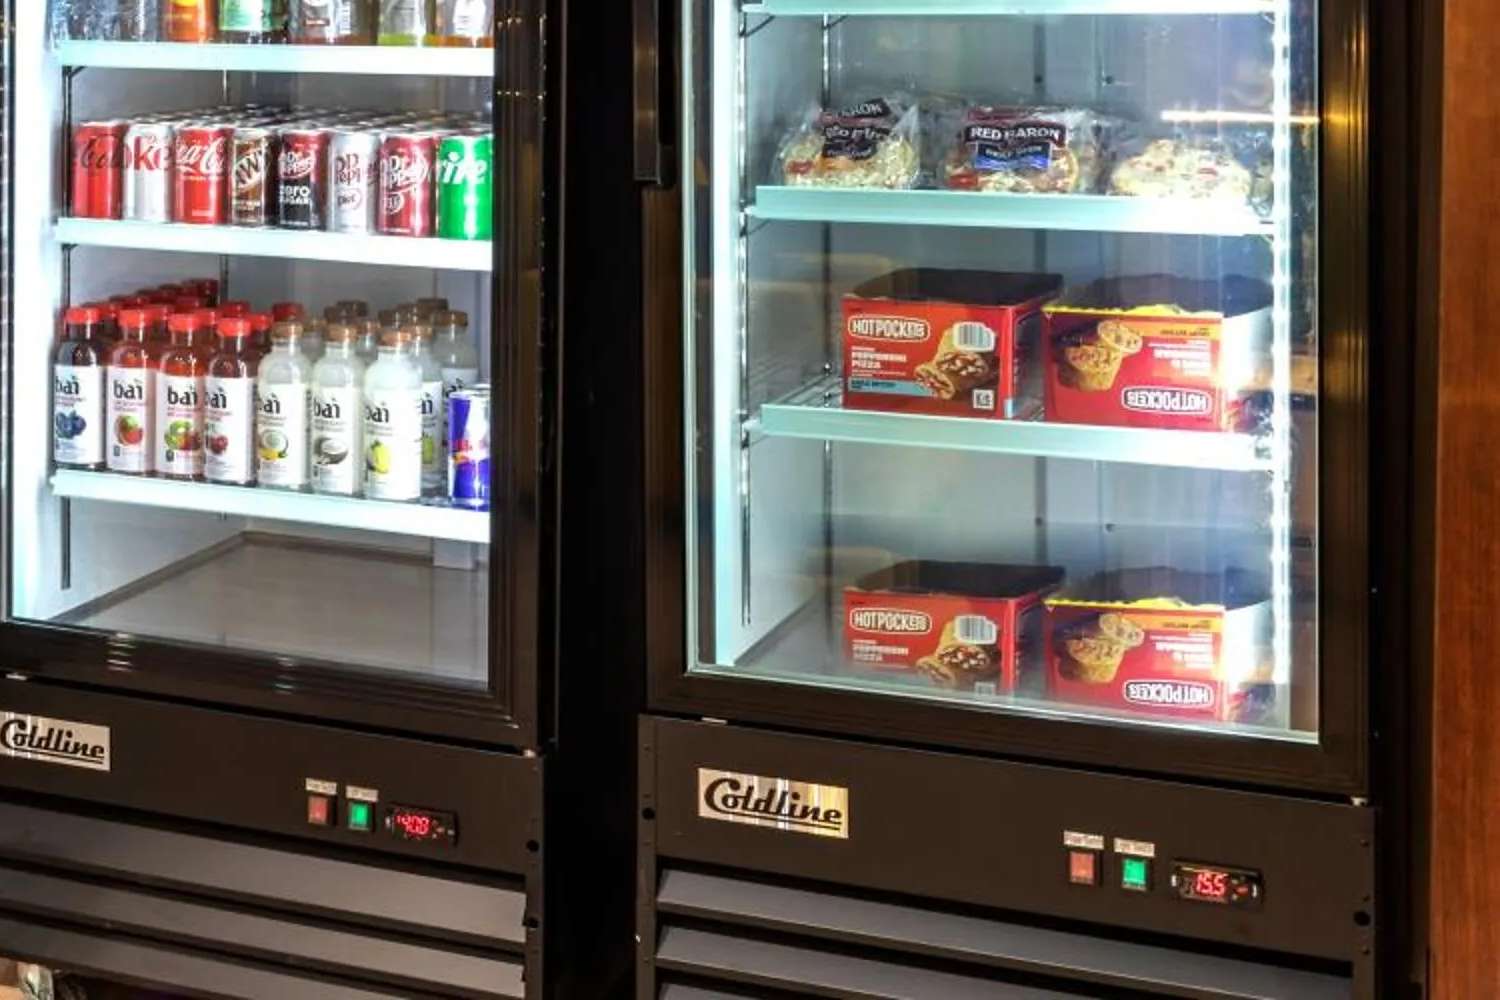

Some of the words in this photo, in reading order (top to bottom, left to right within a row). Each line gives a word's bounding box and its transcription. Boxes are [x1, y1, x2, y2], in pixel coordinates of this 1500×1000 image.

[970, 126, 1001, 141] RED
[852, 318, 875, 334] HOT
[113, 378, 143, 401] bai
[167, 384, 198, 406] bai
[313, 394, 341, 419] bai
[853, 612, 876, 628] HOT
[0, 719, 105, 764] Coldline
[704, 778, 843, 831] Coldline
